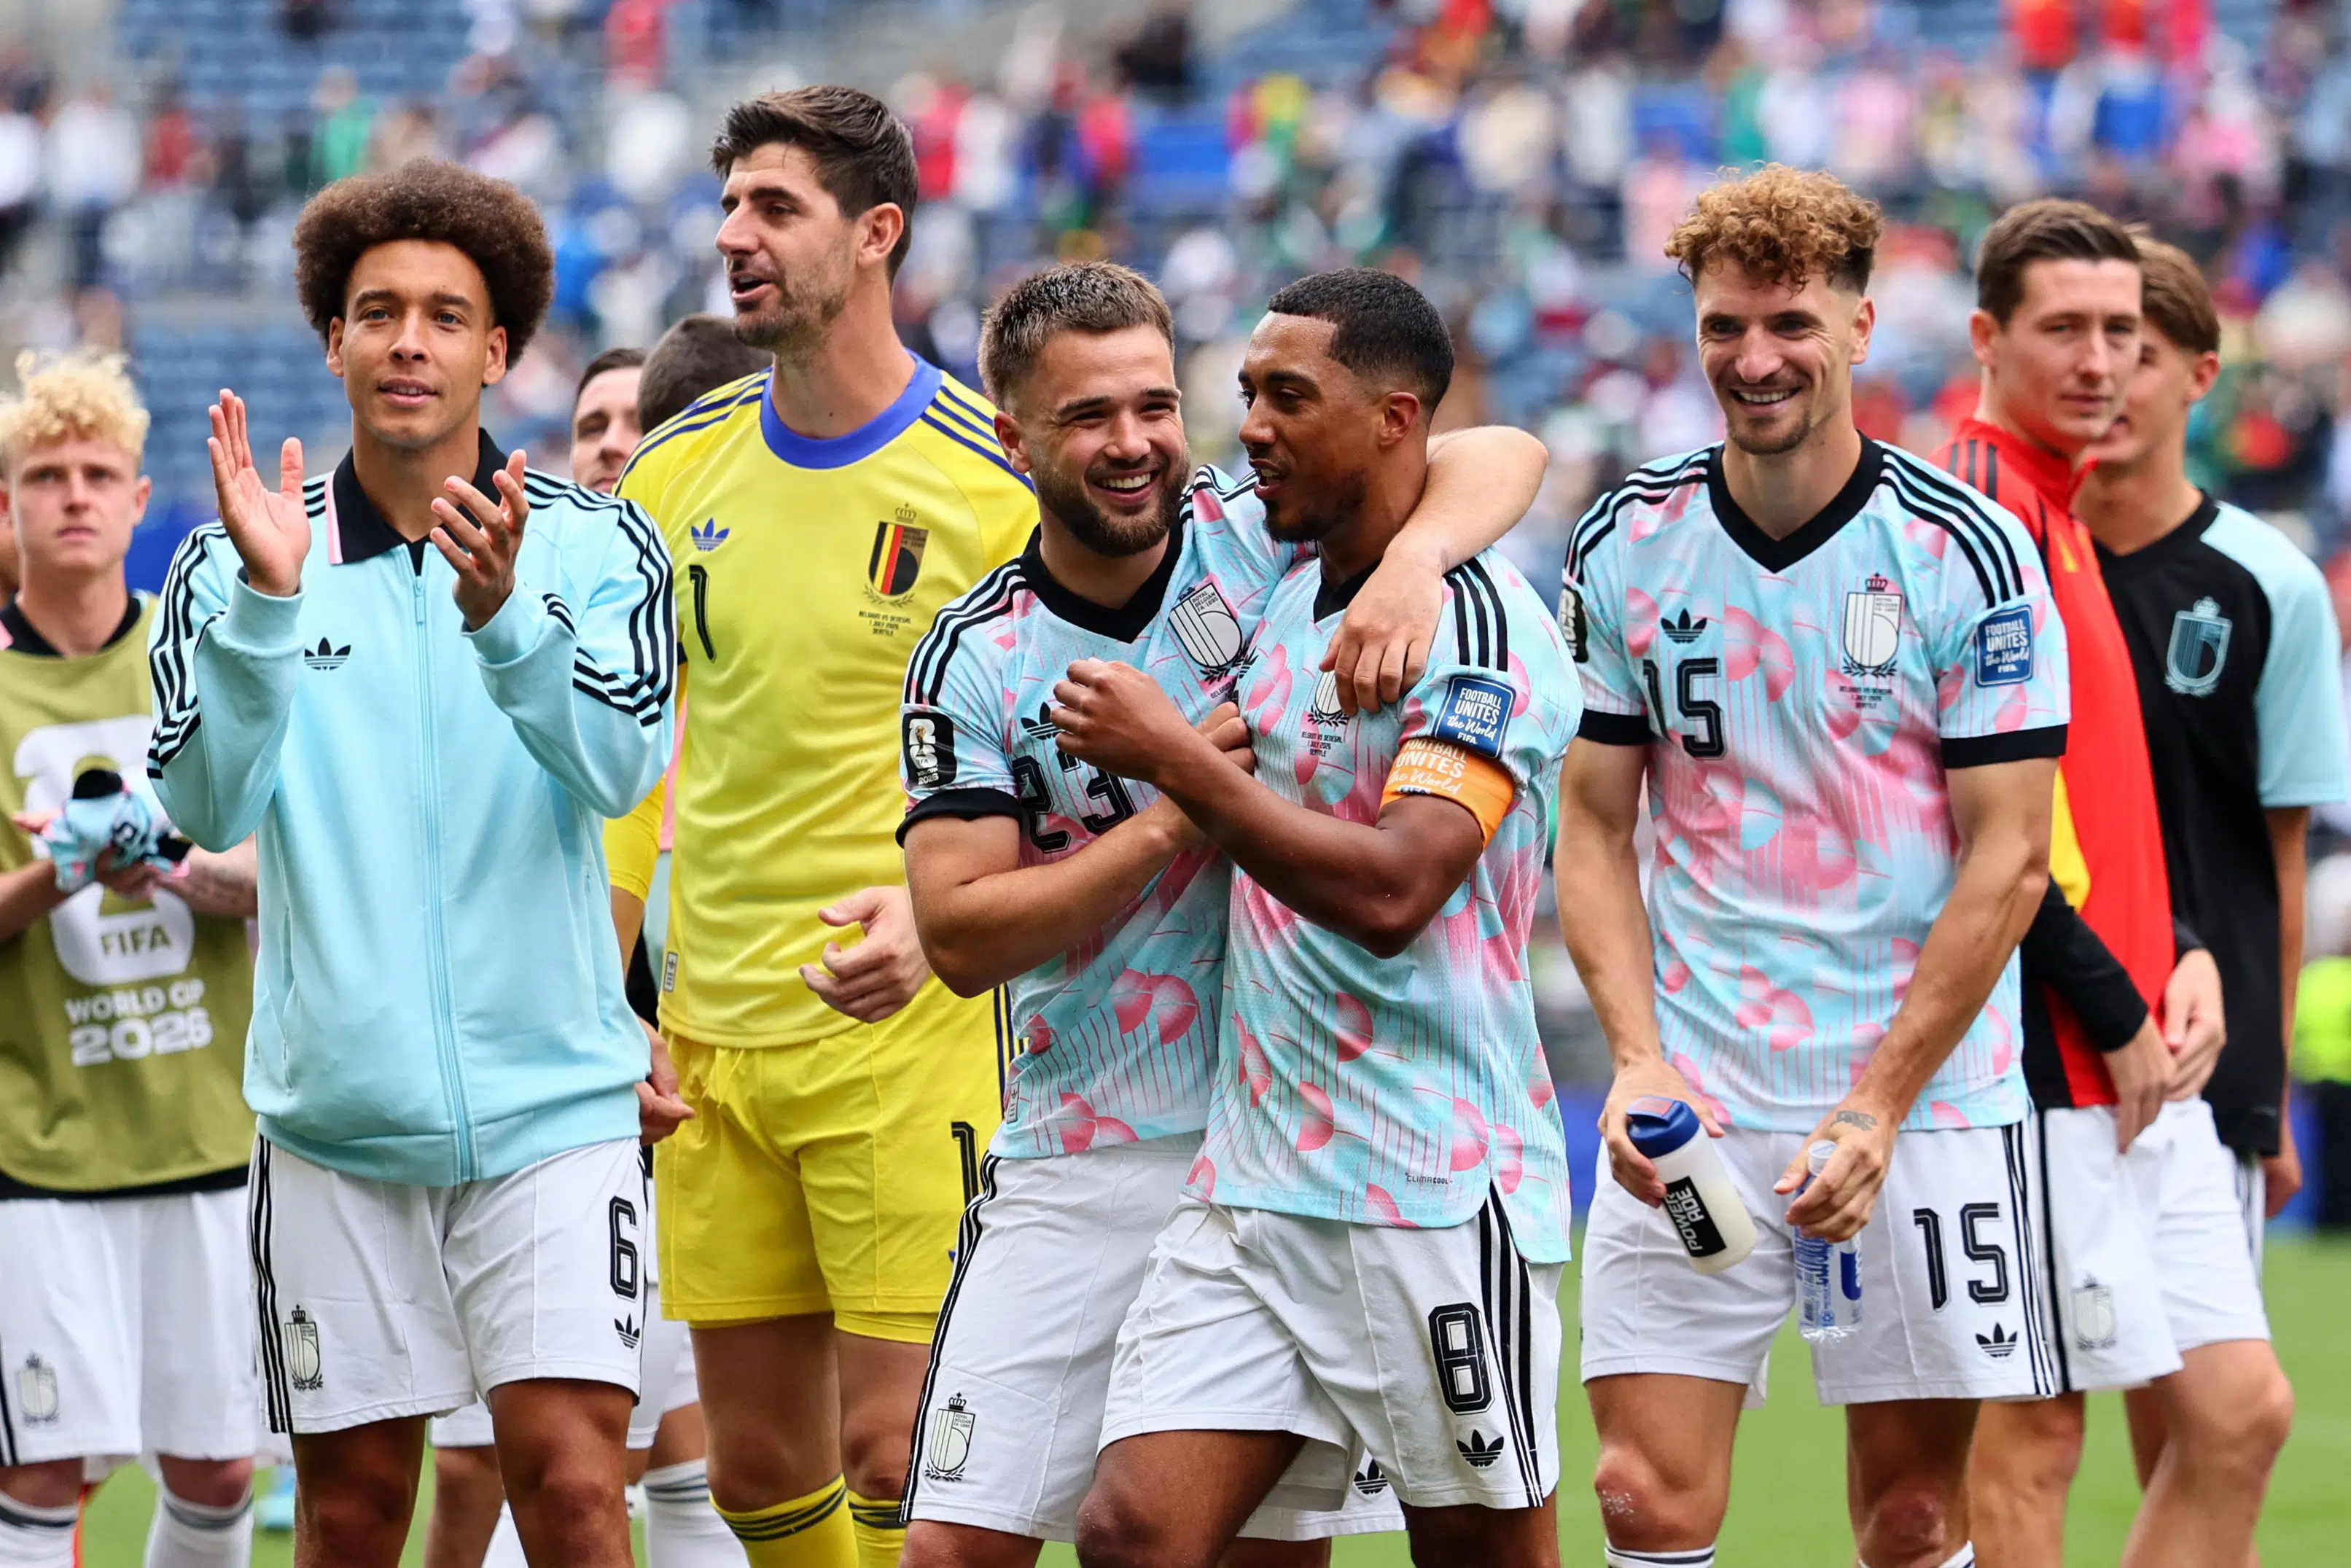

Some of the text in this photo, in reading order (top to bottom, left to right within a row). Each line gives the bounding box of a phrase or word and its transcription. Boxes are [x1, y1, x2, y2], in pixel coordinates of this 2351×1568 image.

[1193, 591, 1208, 603] ROYAL
[1194, 592, 1216, 607] BELGIAN
[689, 565, 717, 663] 1
[1984, 618, 2027, 636] FOOTBALL
[1986, 631, 2029, 652] UNITES
[1984, 647, 2030, 667] the World
[1997, 664, 2018, 674] FIFA
[1454, 699, 1500, 725] UNITES
[1459, 687, 1502, 710] FOOTBALL
[1643, 658, 1728, 762] 15
[1446, 714, 1498, 741] the World
[1457, 731, 1478, 744] FIFA
[1404, 738, 1467, 764] FOOTBALL
[1395, 751, 1465, 779] UNITES
[918, 773, 940, 786] 2026
[1387, 768, 1464, 795] the World
[1013, 750, 1138, 854] 23
[100, 924, 172, 956] FIFA
[69, 1006, 214, 1067] 2026
[1406, 1174, 1449, 1185] CLIMACOOL
[1676, 1185, 1705, 1222] ADE
[1665, 1193, 1704, 1251] POWER
[609, 1195, 639, 1303] 6
[1913, 1202, 2011, 1313] 15
[1428, 1301, 1495, 1416] 8
